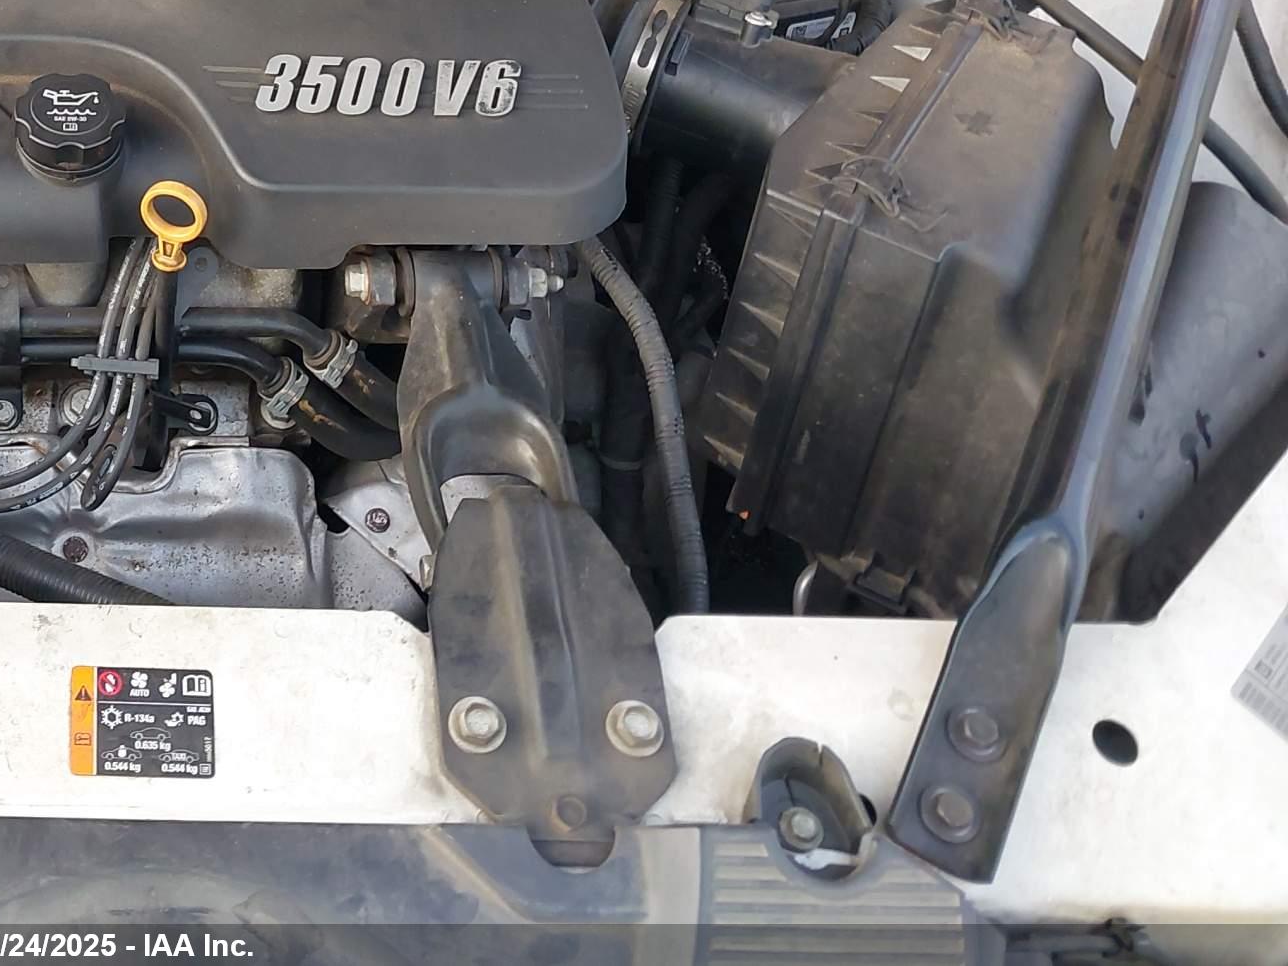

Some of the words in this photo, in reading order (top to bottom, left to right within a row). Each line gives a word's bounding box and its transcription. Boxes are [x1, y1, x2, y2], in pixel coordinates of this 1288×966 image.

[254, 54, 426, 116] 3500
[433, 59, 522, 116] V6
[130, 689, 149, 697] AUTO
[124, 713, 155, 723] R-134a
[188, 715, 206, 725] PAG
[135, 741, 158, 750] 0.635
[159, 741, 171, 751] kg
[104, 762, 128, 770] 0.544
[129, 762, 141, 773] kg
[161, 763, 185, 772] 0.544
[186, 764, 198, 774] kg
